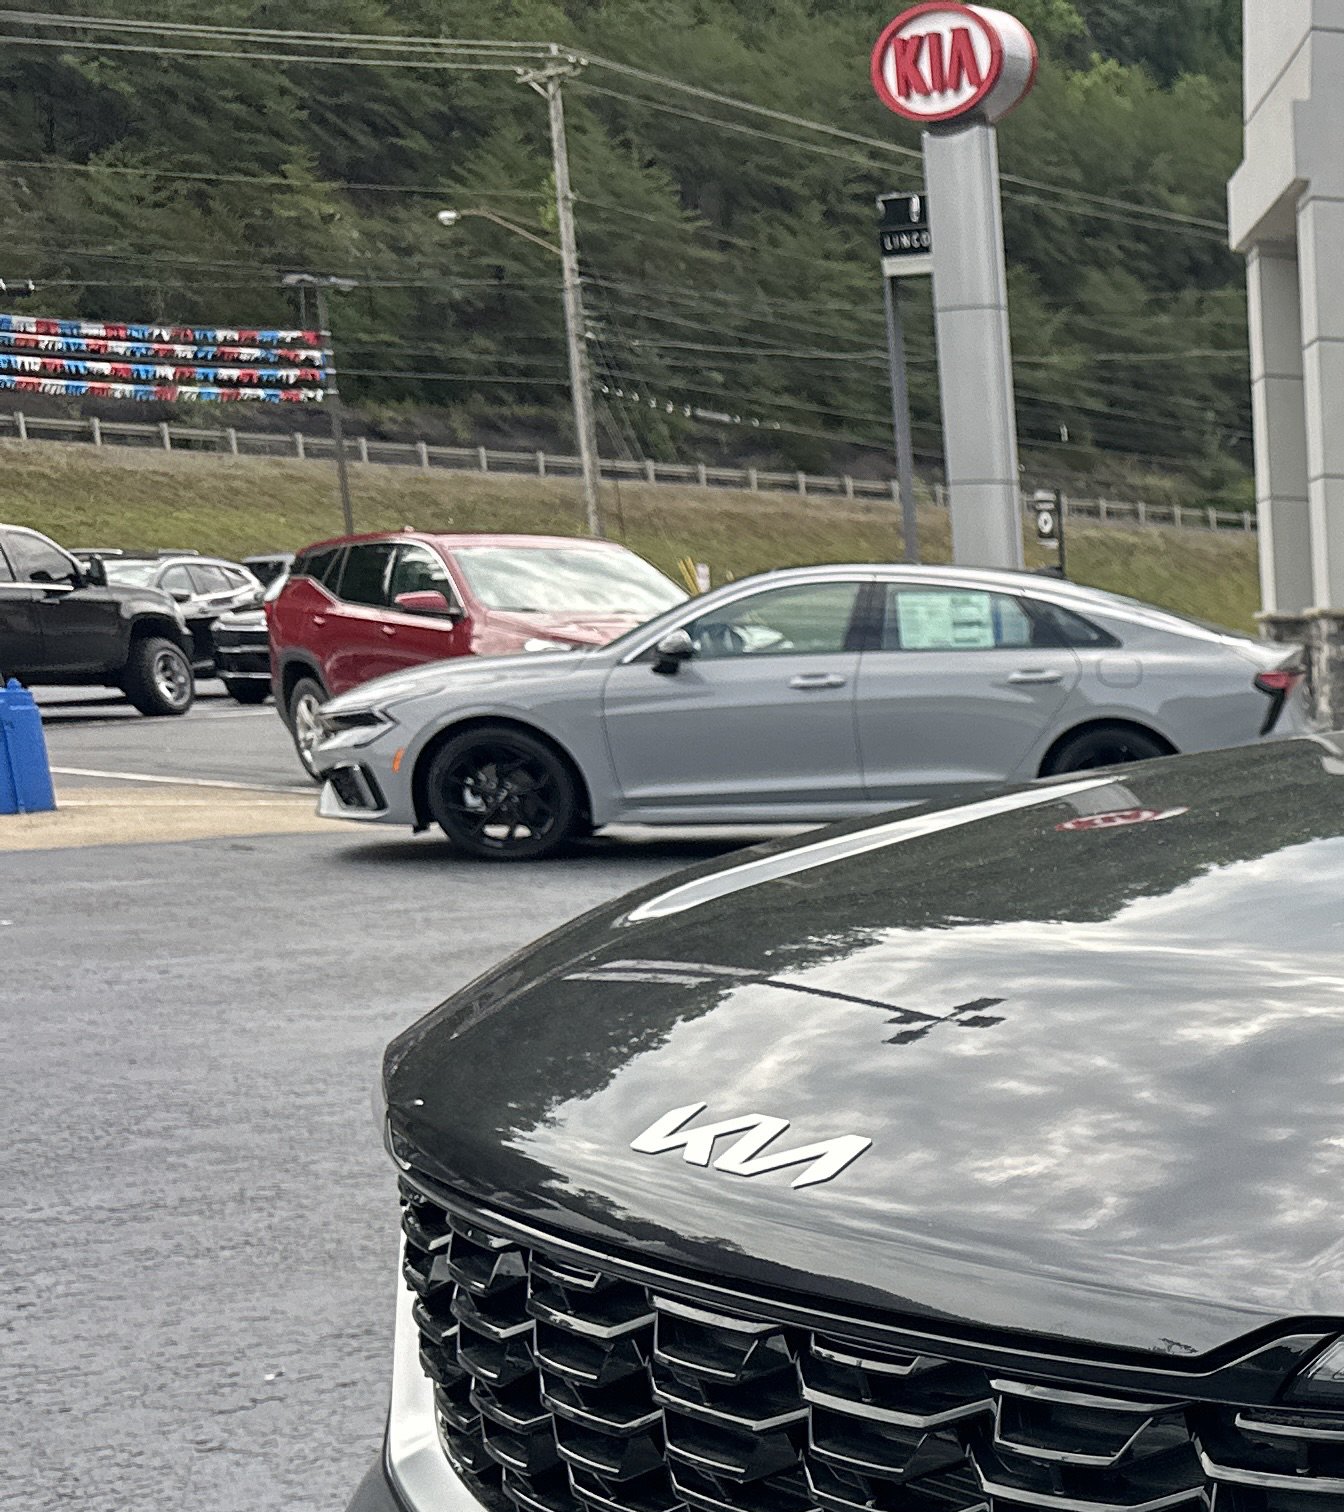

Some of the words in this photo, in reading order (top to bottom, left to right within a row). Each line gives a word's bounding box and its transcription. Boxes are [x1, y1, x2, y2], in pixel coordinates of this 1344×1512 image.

[894, 27, 982, 99] KIA
[883, 230, 931, 251] LINCO
[629, 1100, 873, 1190] KIA
